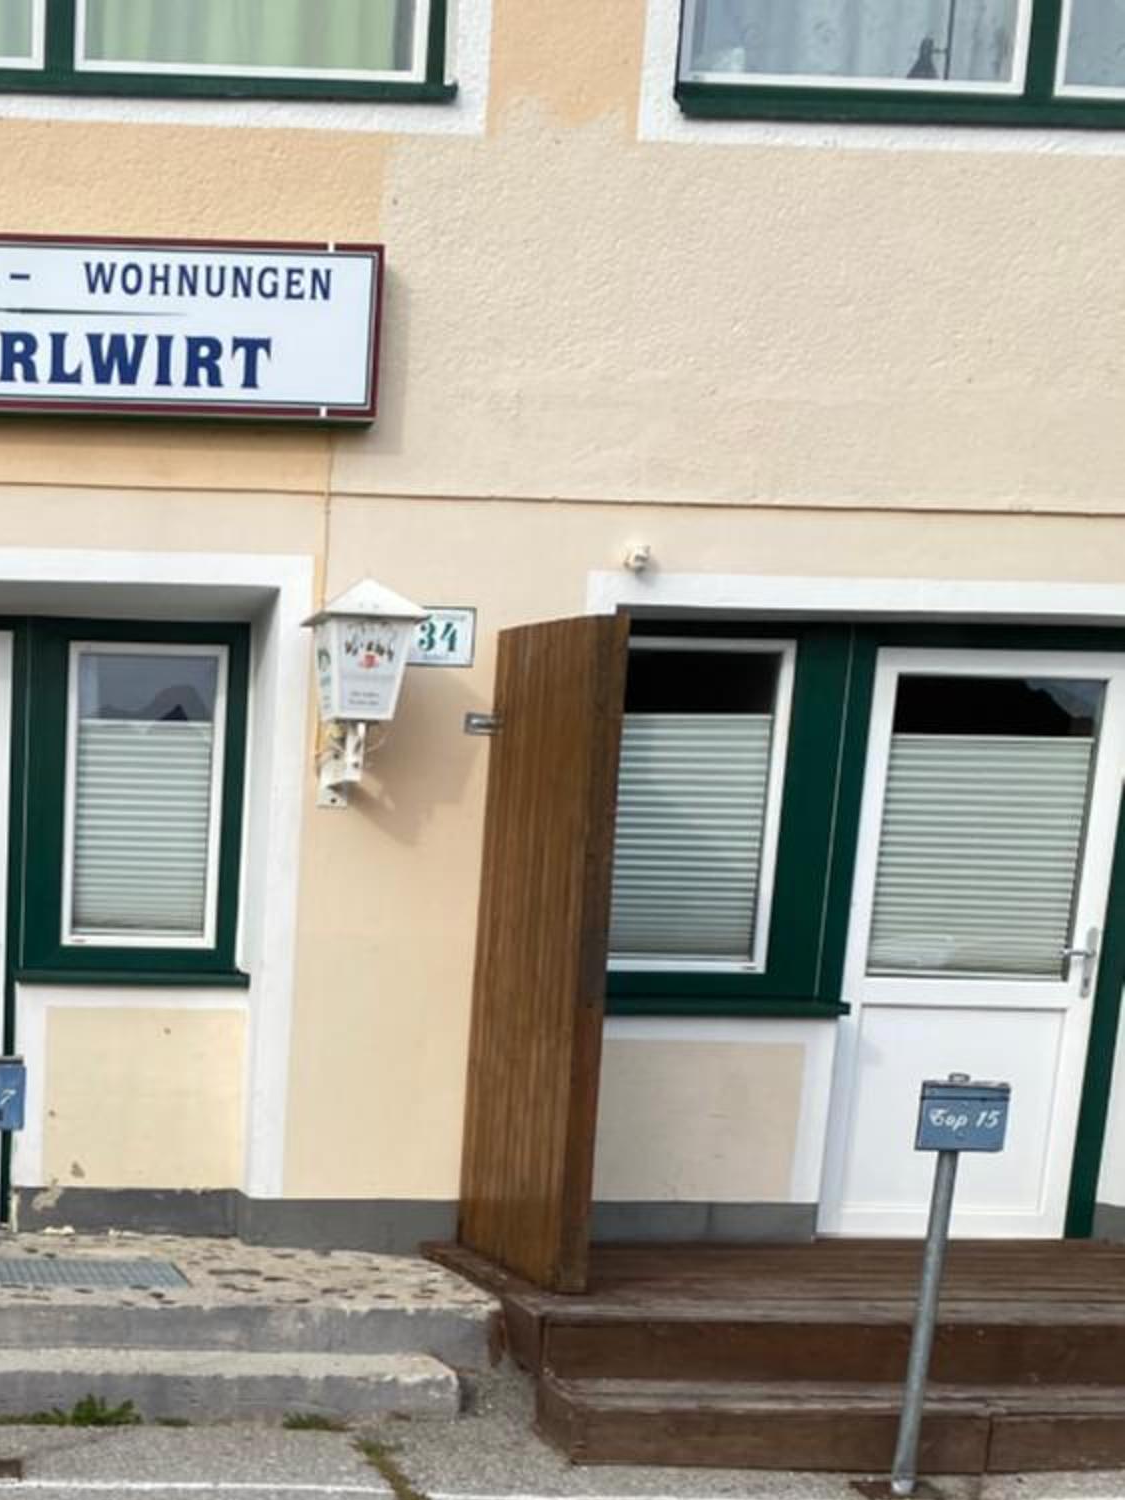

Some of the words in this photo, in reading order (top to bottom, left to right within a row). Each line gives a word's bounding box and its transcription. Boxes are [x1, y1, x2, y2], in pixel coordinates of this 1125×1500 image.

[83, 261, 332, 301] WOHNUNGEN
[419, 622, 457, 652] 34
[0, 1088, 17, 1107] 7
[929, 1108, 968, 1131] Top
[976, 1109, 1001, 1128] 15
